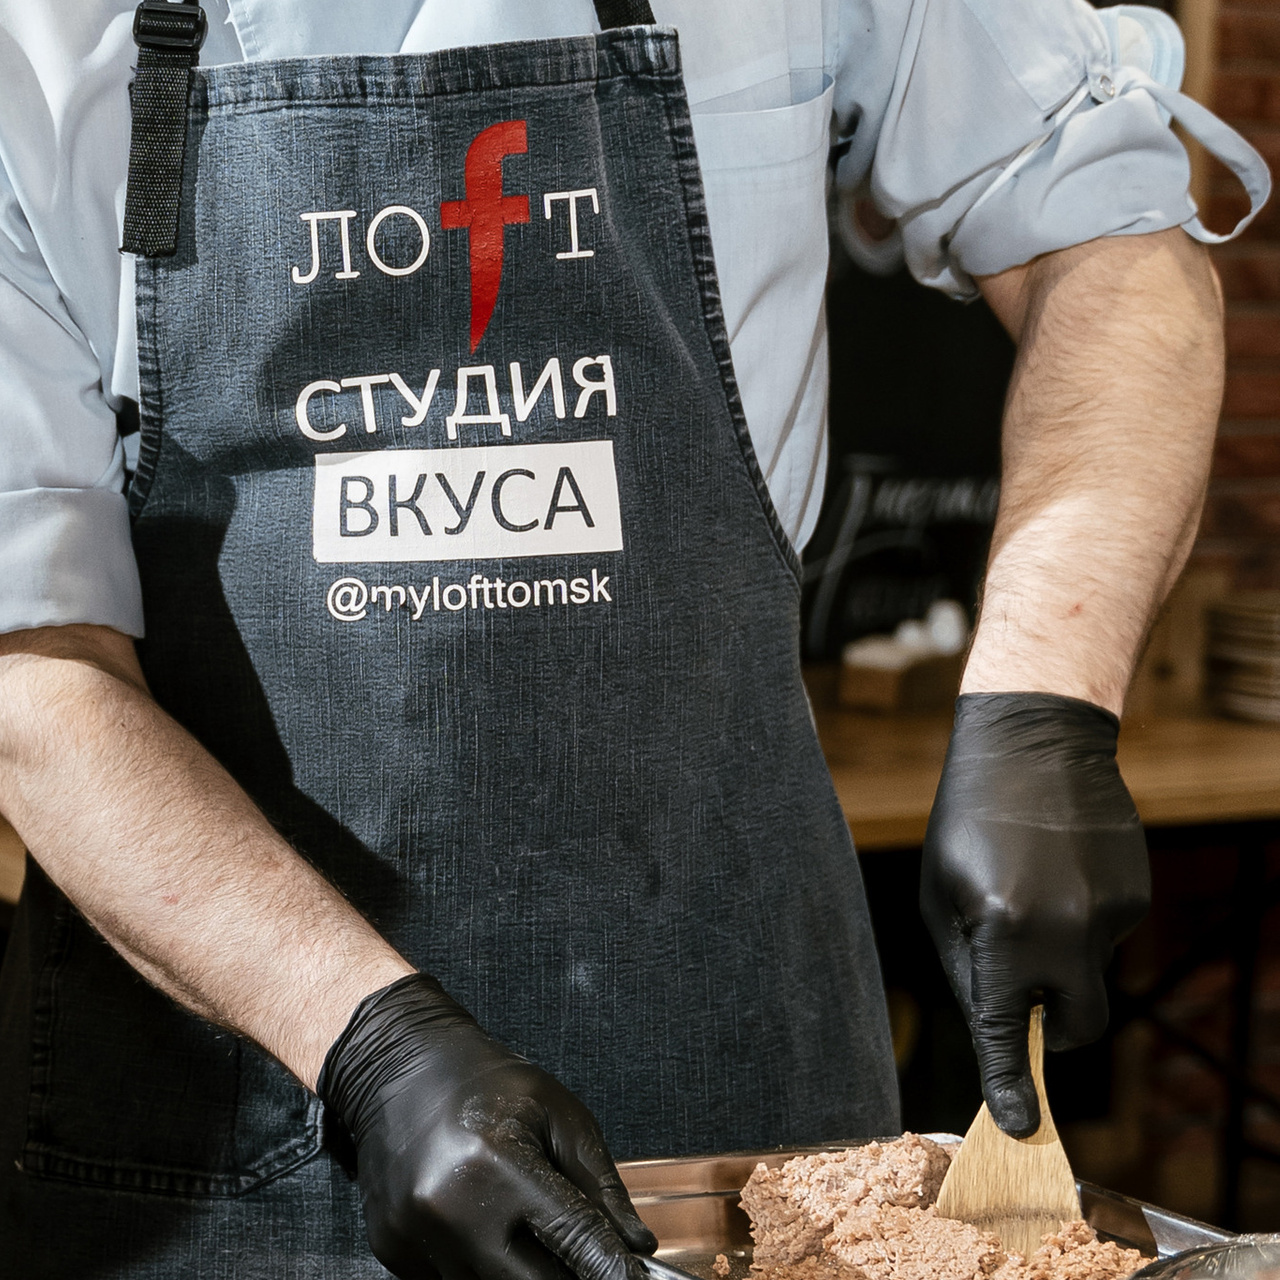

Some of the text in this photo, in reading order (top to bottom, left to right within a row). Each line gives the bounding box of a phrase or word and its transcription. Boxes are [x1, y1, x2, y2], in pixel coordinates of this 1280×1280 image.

[295, 354, 617, 441] СТУДИЯ
[338, 465, 596, 539] ВКУСА
[326, 568, 612, 621] @mylofttomsk
